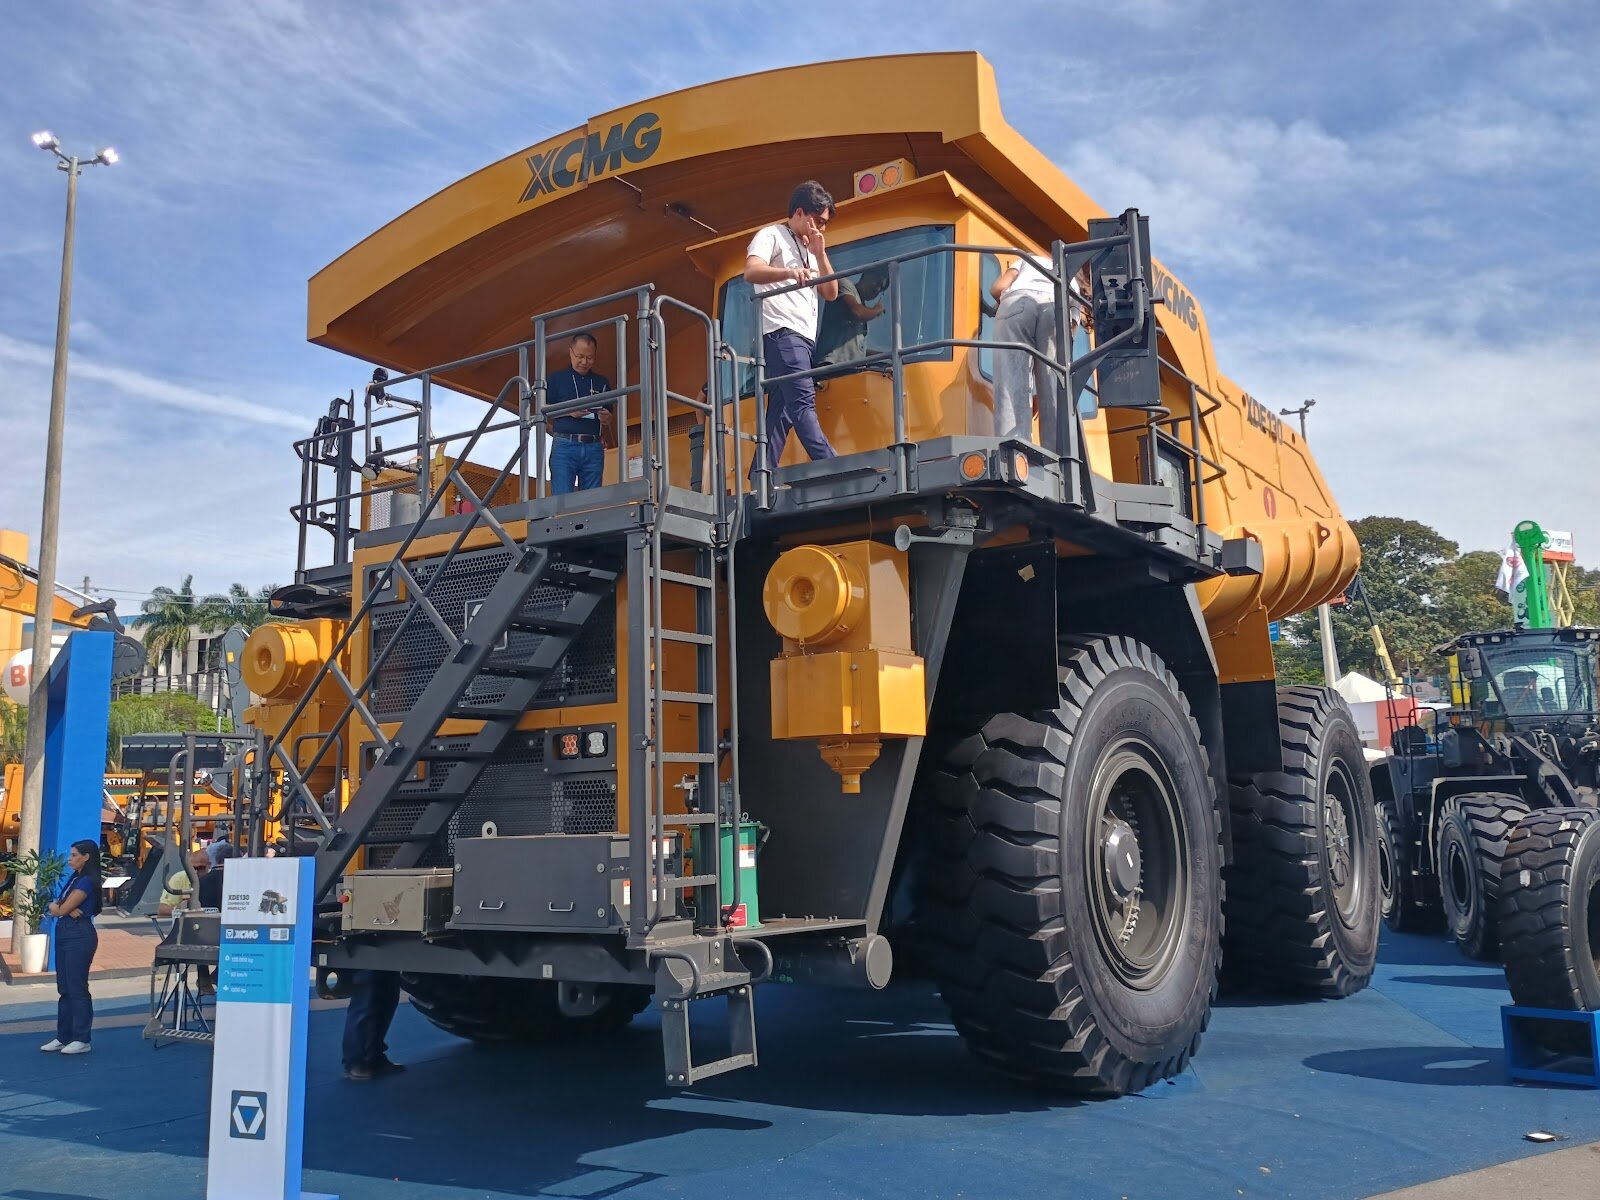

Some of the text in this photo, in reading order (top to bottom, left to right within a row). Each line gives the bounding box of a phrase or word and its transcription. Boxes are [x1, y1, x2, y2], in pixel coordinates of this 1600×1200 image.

[517, 112, 662, 203] XCMG
[1245, 392, 1283, 445] XDE130
[10, 664, 34, 687] B
[233, 930, 259, 939] XCMG
